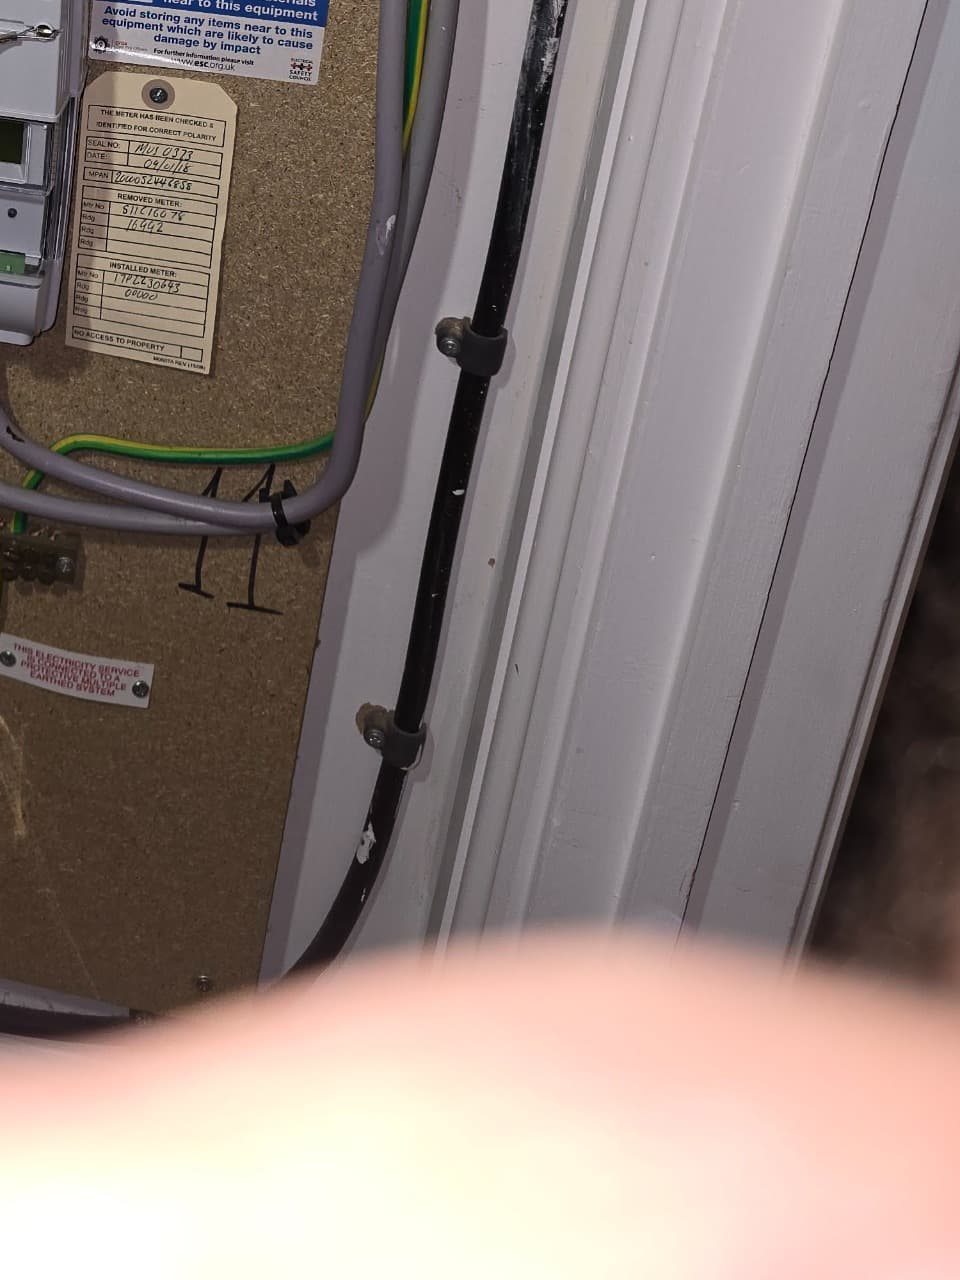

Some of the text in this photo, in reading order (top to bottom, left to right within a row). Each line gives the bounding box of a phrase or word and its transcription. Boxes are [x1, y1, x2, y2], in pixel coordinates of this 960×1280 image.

[216, 0, 241, 12] this
[244, 4, 319, 21] equipment
[104, 5, 313, 39] Avoid storing any items near to this
[102, 18, 313, 50] equipment which are likely to cause
[153, 33, 200, 48] damage
[203, 39, 217, 51] by
[220, 42, 261, 55] impact
[164, 49, 241, 64] further information please
[101, 109, 114, 117] THE
[115, 111, 138, 119] METER
[155, 114, 174, 123] BEEN
[175, 117, 208, 128] CHECKED
[96, 121, 133, 130] IDENTIFIED
[149, 126, 181, 136] CORRECT
[183, 131, 217, 142] POLARITY
[88, 171, 109, 179] MPAN
[117, 193, 182, 207] REMOVED METER:
[109, 262, 177, 277] INSTALLED METER:
[85, 331, 165, 352] ACCESS PROPERTY
[13, 643, 140, 677] THIS ELECTRICITY SERVICE
[37, 659, 98, 679] CONNECTED
[20, 660, 126, 691] PROTECTIVE MULTIPLE
[30, 671, 115, 697] EARTHED SYSTEM
